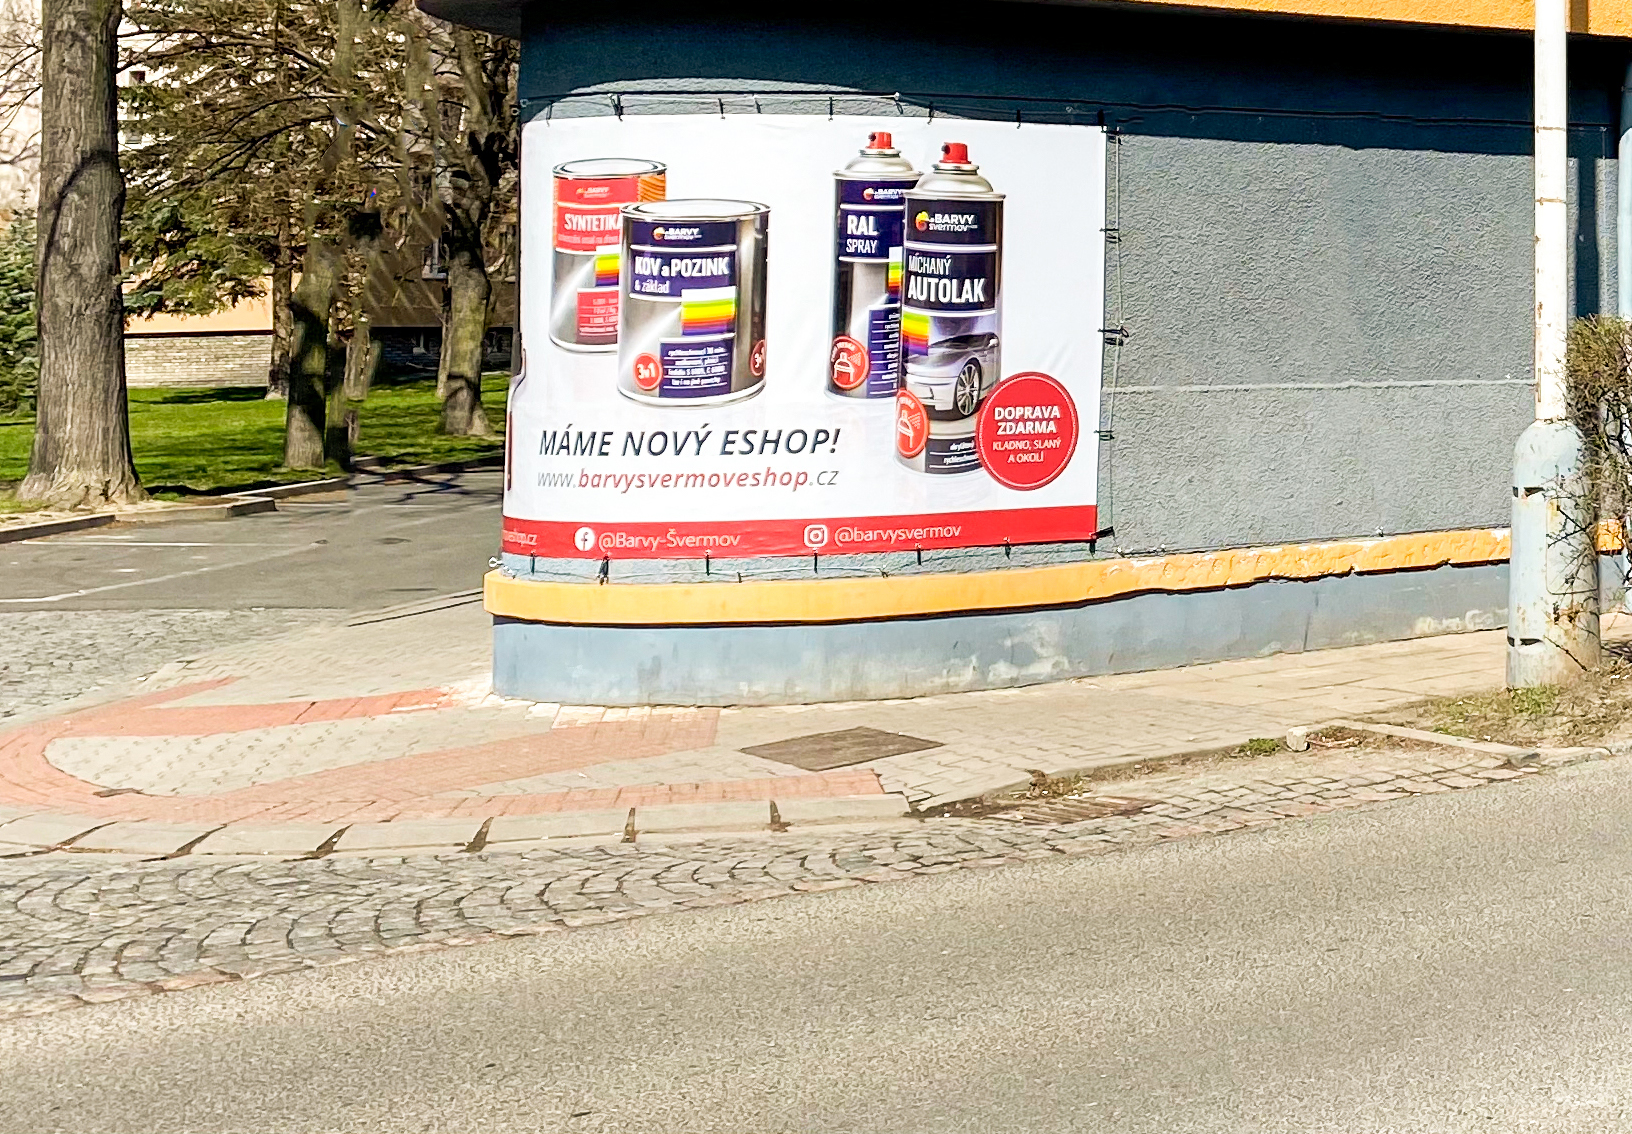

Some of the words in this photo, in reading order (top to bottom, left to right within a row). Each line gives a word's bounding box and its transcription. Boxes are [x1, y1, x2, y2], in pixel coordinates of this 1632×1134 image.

[847, 215, 878, 236] RAL
[935, 213, 975, 225] BARVY
[846, 239, 877, 254] SPRAY
[635, 256, 662, 276] KOV
[661, 265, 670, 277] a
[670, 257, 730, 277] POZINK
[909, 252, 951, 275] MÍCHANÝ
[641, 278, 670, 294] základ
[908, 276, 986, 303] AUTOLAK
[994, 405, 1061, 420] DOPRAVA
[997, 422, 1057, 436] ZDARMA
[539, 423, 614, 457] MÁME
[621, 422, 713, 457] NOVÝ
[719, 427, 842, 456] ESHOP!
[992, 440, 1032, 452] KLADNO,
[1033, 437, 1062, 450] SLANÝ
[1007, 454, 1016, 464] A
[1016, 451, 1044, 464] OKOLÍ
[537, 465, 840, 495] www.barvysvermoveshop.cz
[598, 528, 741, 553] @Barvy-Švermov
[834, 525, 962, 547] @barvysvermov
